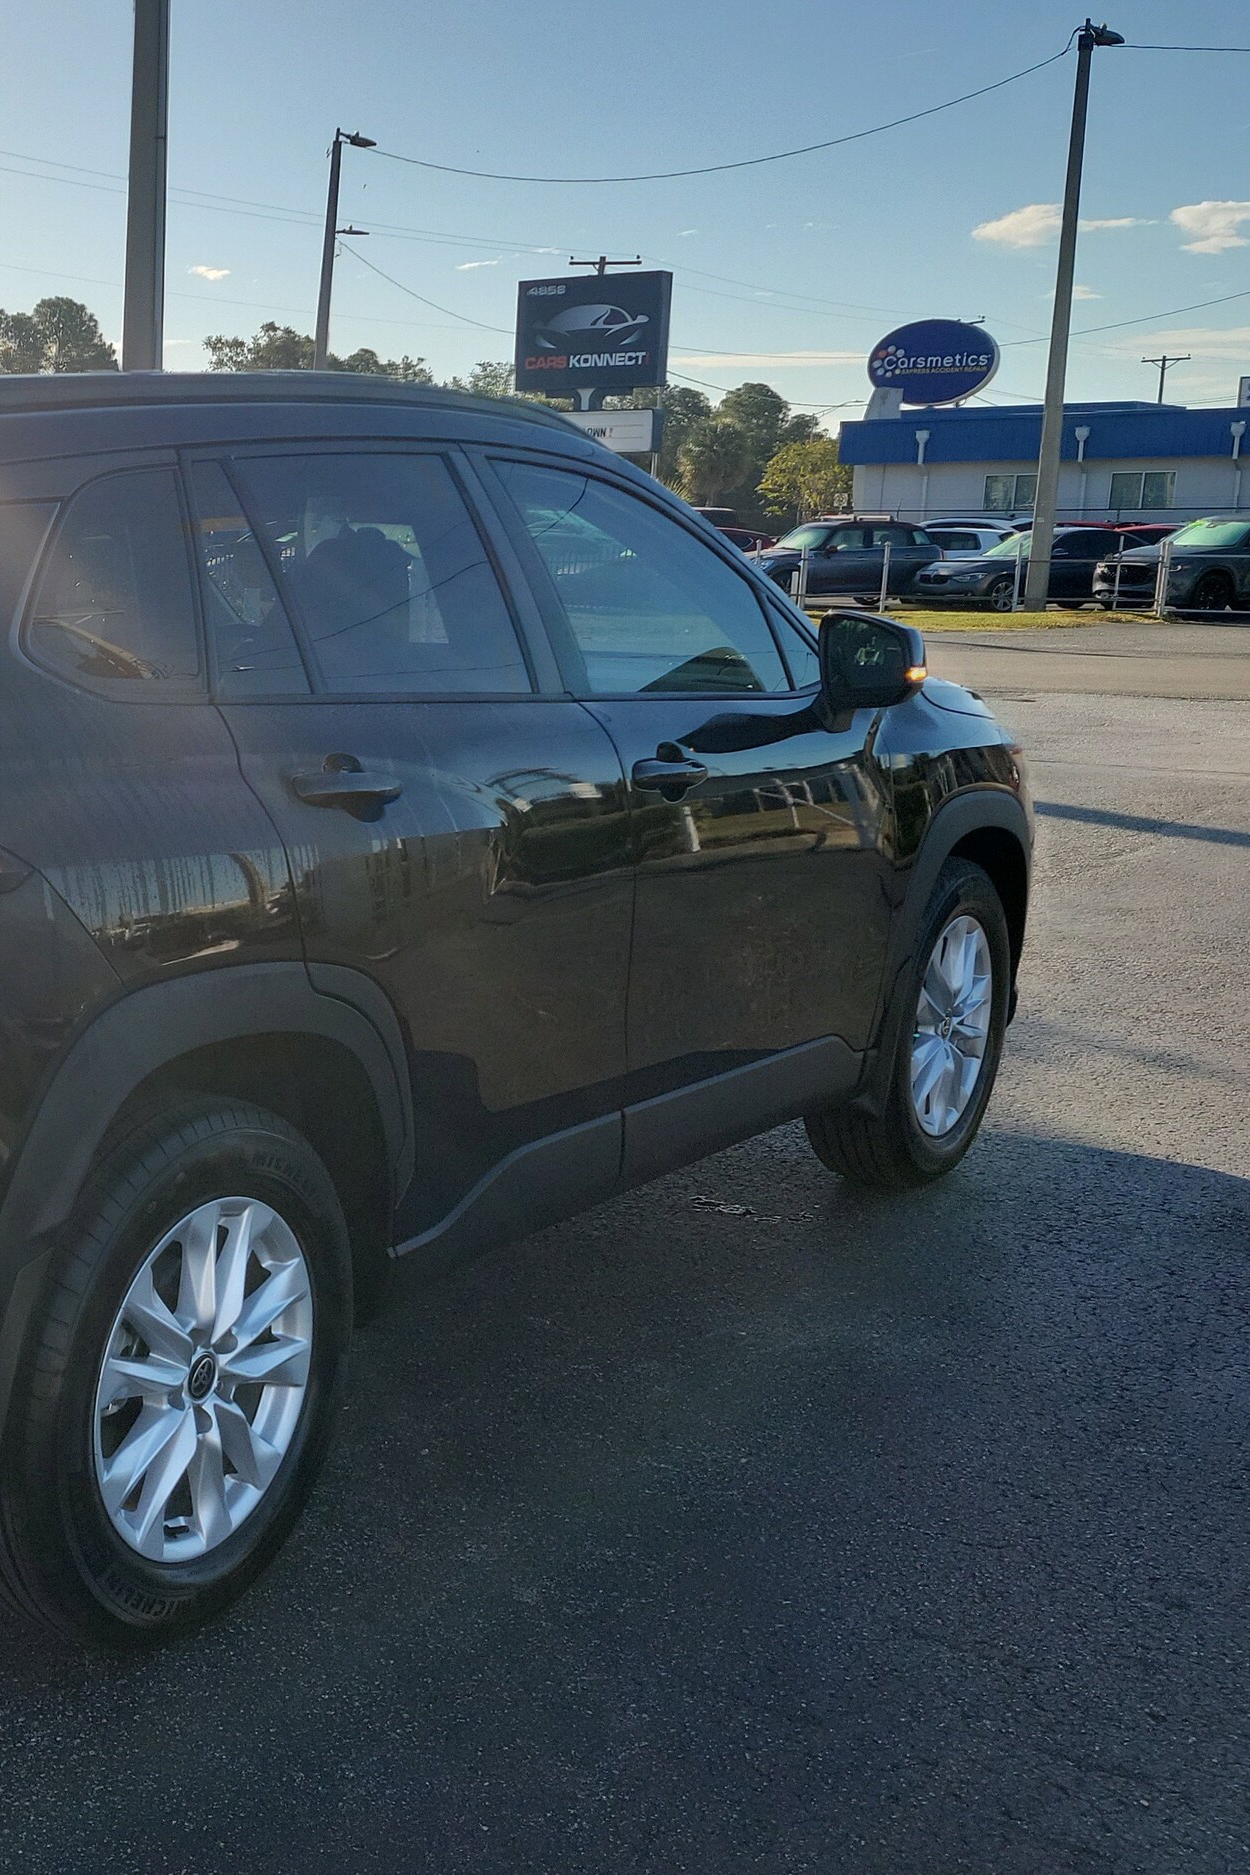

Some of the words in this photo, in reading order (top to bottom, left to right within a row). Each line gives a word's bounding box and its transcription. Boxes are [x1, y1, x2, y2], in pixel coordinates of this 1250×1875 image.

[525, 355, 567, 370] CARS
[568, 351, 646, 369] KONNECT
[883, 351, 989, 370] Carsmetics
[584, 427, 607, 438] OWN
